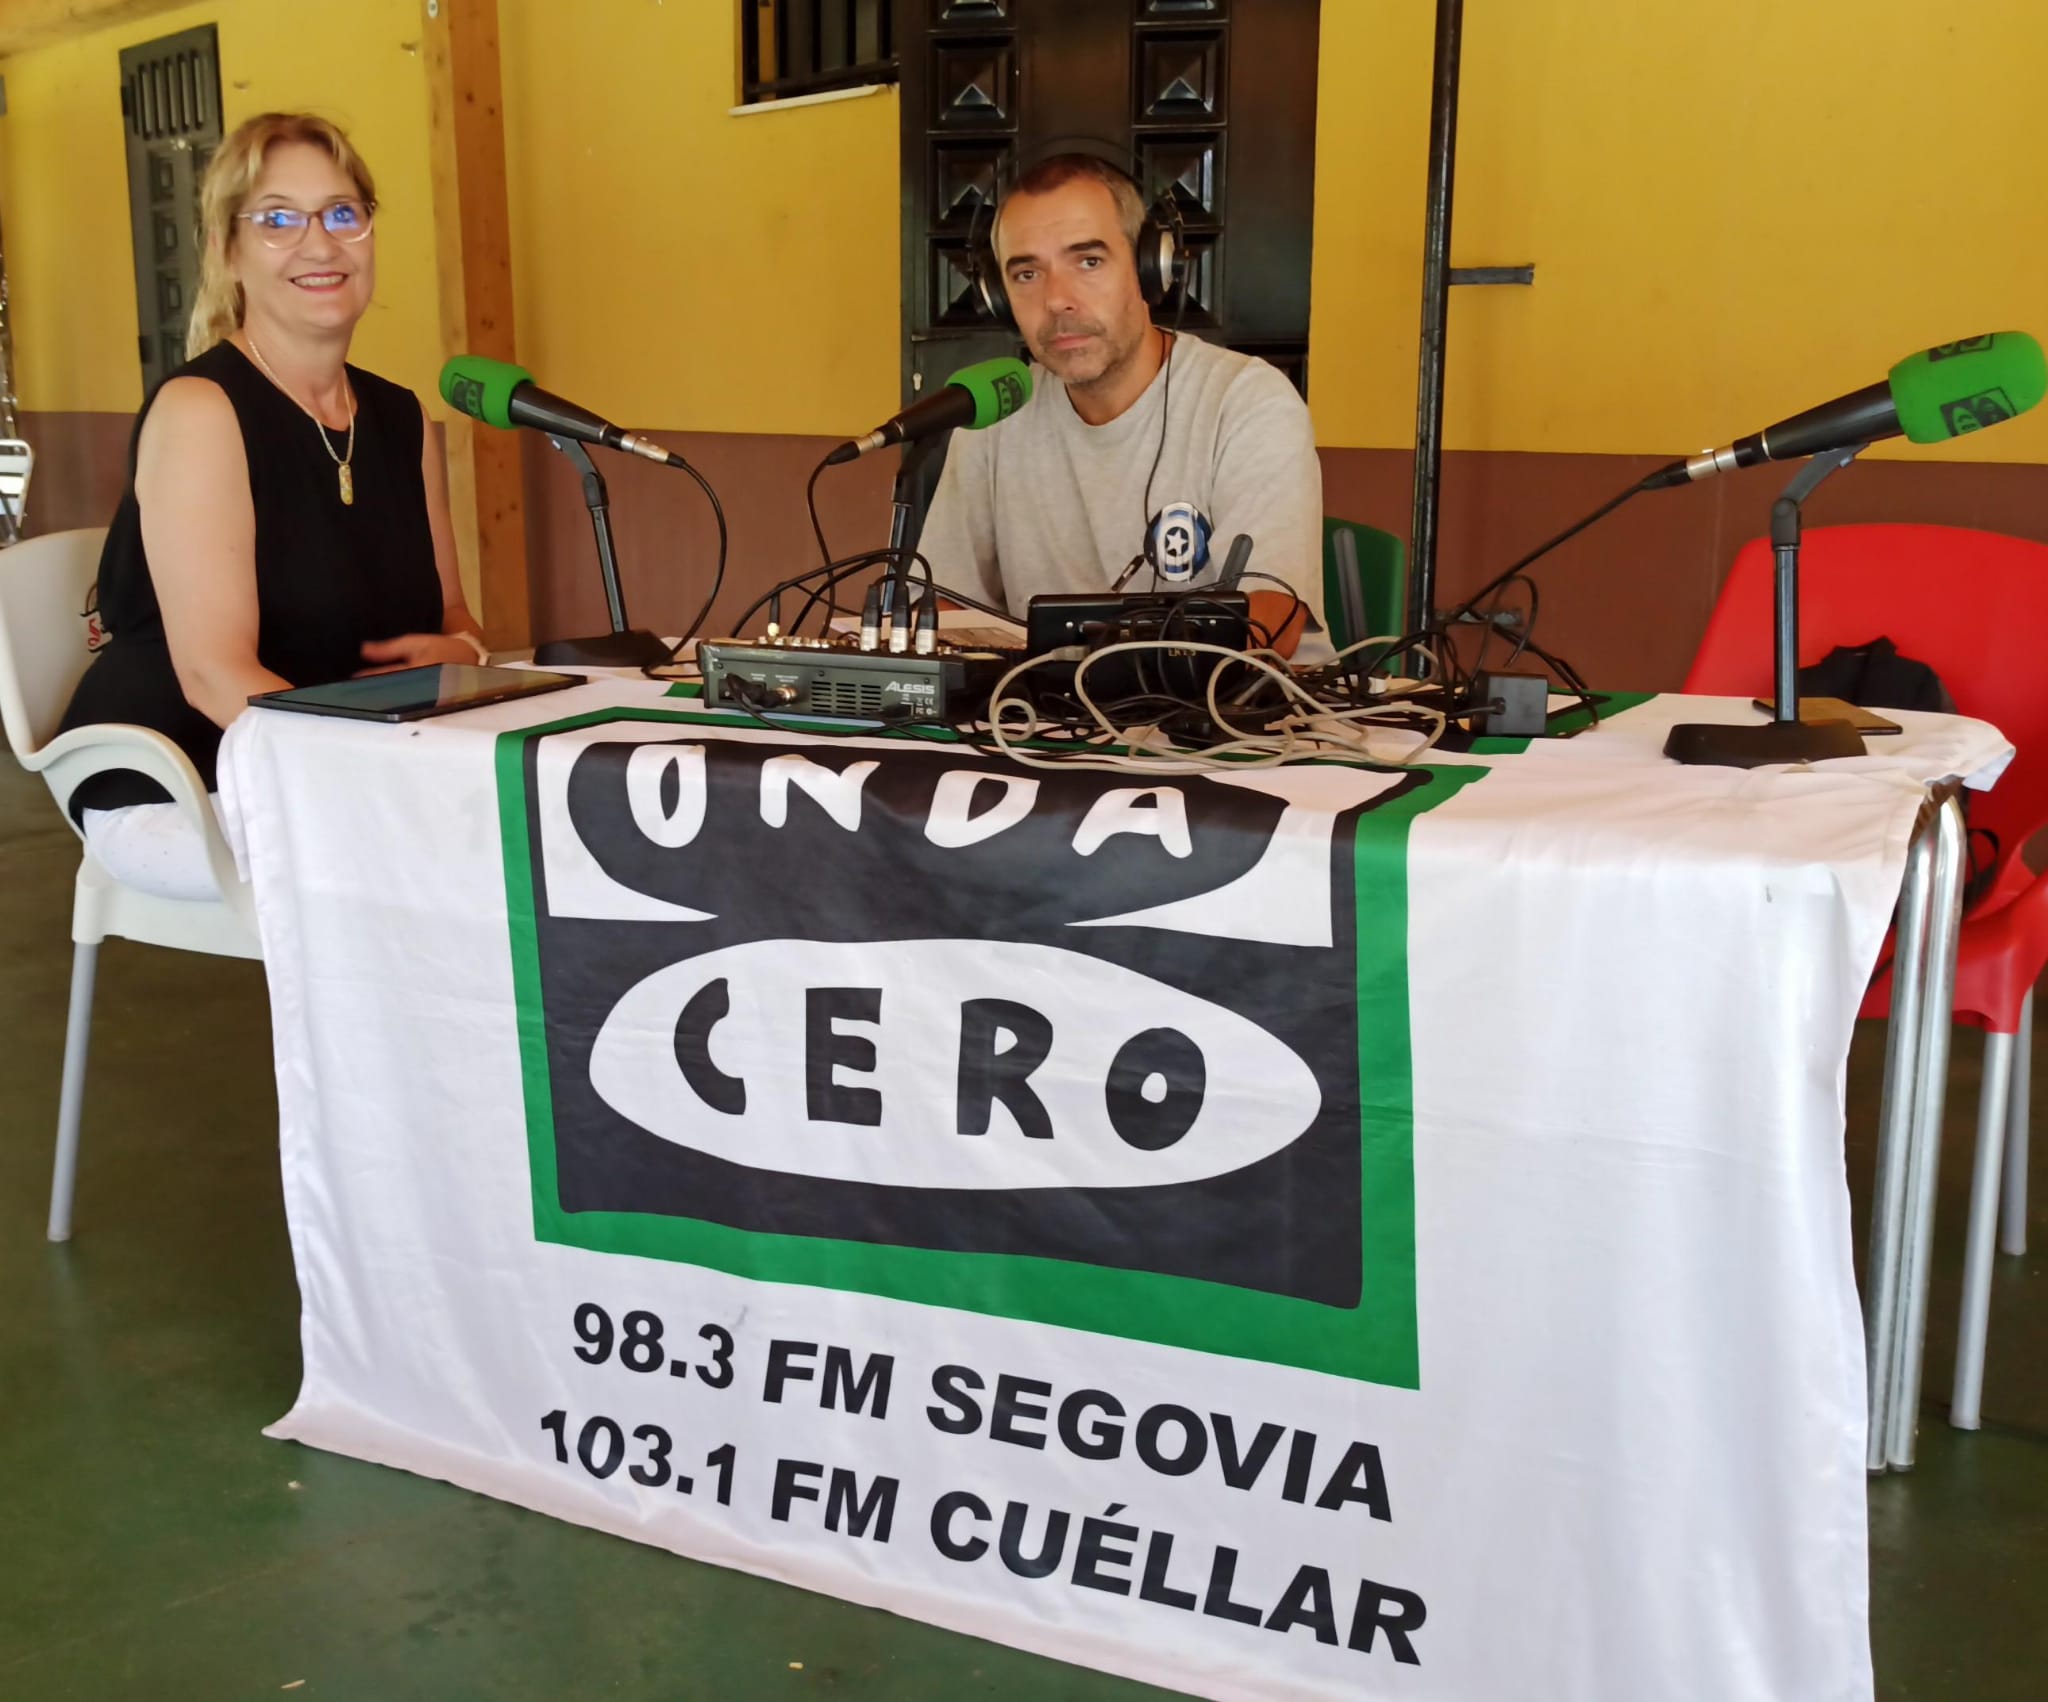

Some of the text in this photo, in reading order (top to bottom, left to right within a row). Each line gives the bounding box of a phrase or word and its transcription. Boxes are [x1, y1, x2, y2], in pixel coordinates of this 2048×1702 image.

[885, 681, 935, 694] ALESIS
[625, 743, 1193, 859] ONDA
[673, 976, 1207, 1152] CERO
[572, 1302, 1393, 1523] 98.3 FM SEGOVIA
[540, 1409, 1428, 1666] 103.1 FM CUÉLLAR
